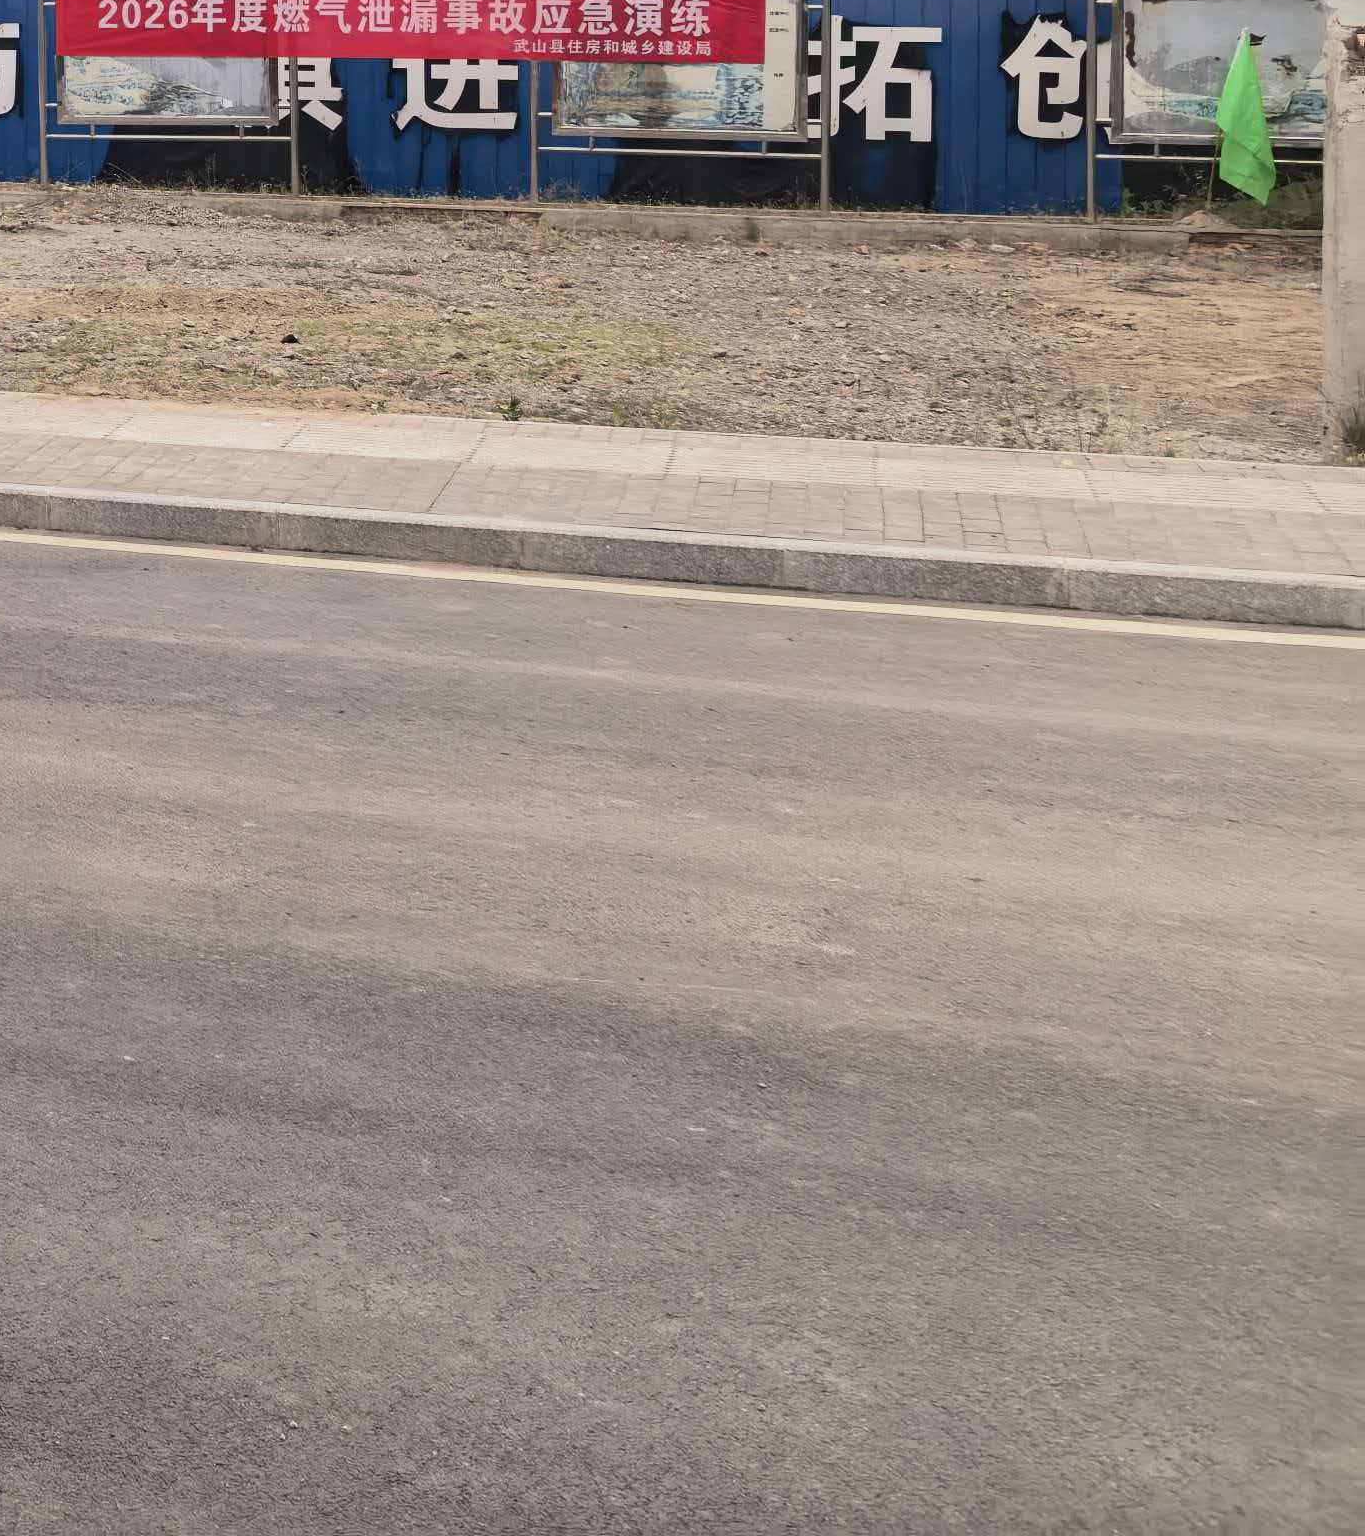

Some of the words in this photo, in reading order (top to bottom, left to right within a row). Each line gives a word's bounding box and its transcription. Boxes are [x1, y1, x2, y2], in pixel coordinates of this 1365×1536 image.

[513, 39, 712, 56] 武山县住房和城乡建设局
